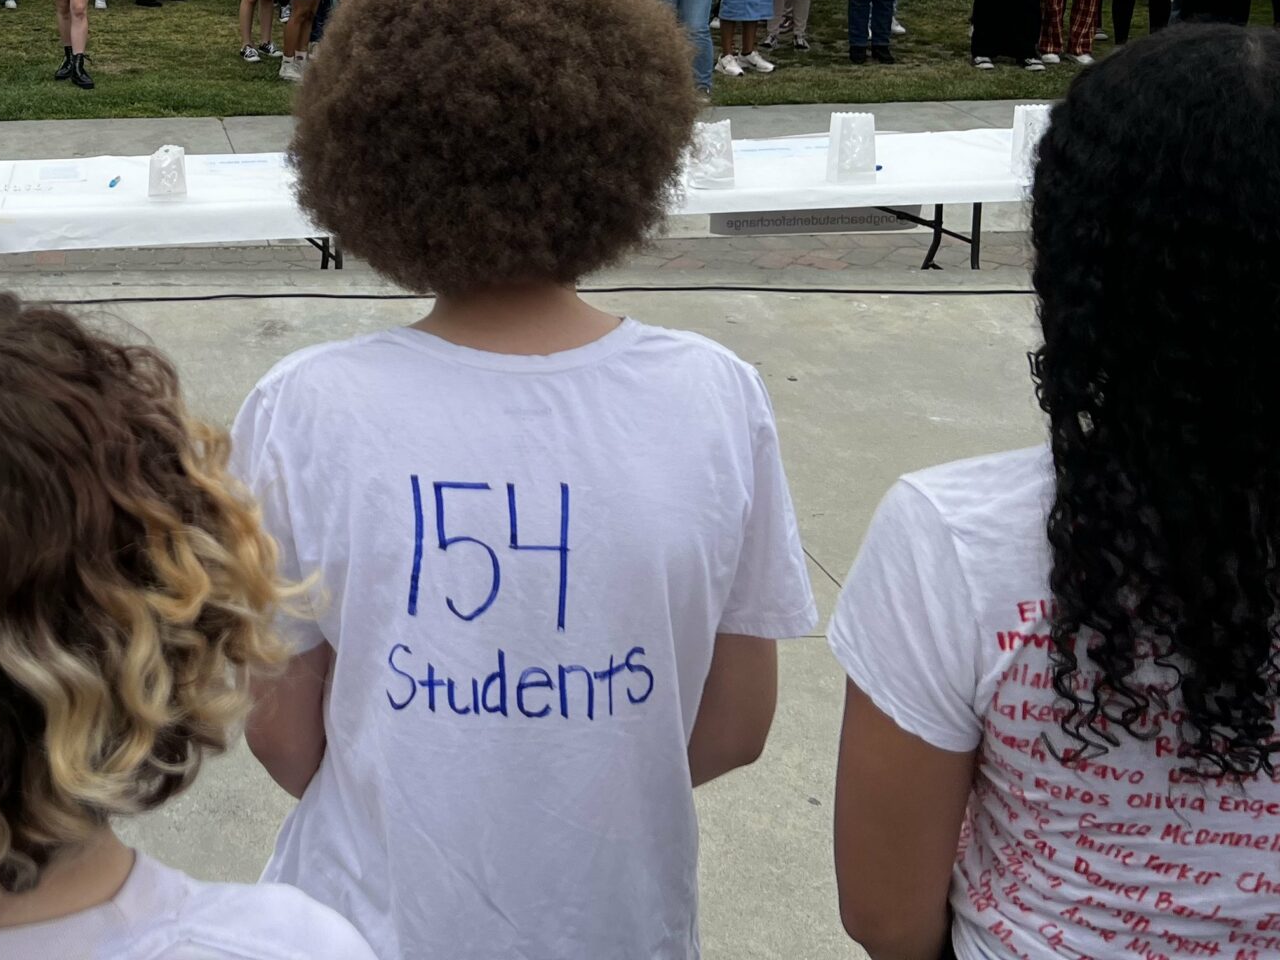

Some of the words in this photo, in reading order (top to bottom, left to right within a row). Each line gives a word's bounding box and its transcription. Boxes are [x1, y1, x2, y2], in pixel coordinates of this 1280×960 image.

[406, 474, 571, 632] 154
[386, 643, 655, 721] Students
[1034, 776, 1110, 808] Rekos
[1126, 791, 1206, 814] Olivia
[1073, 855, 1150, 903] Daniel
